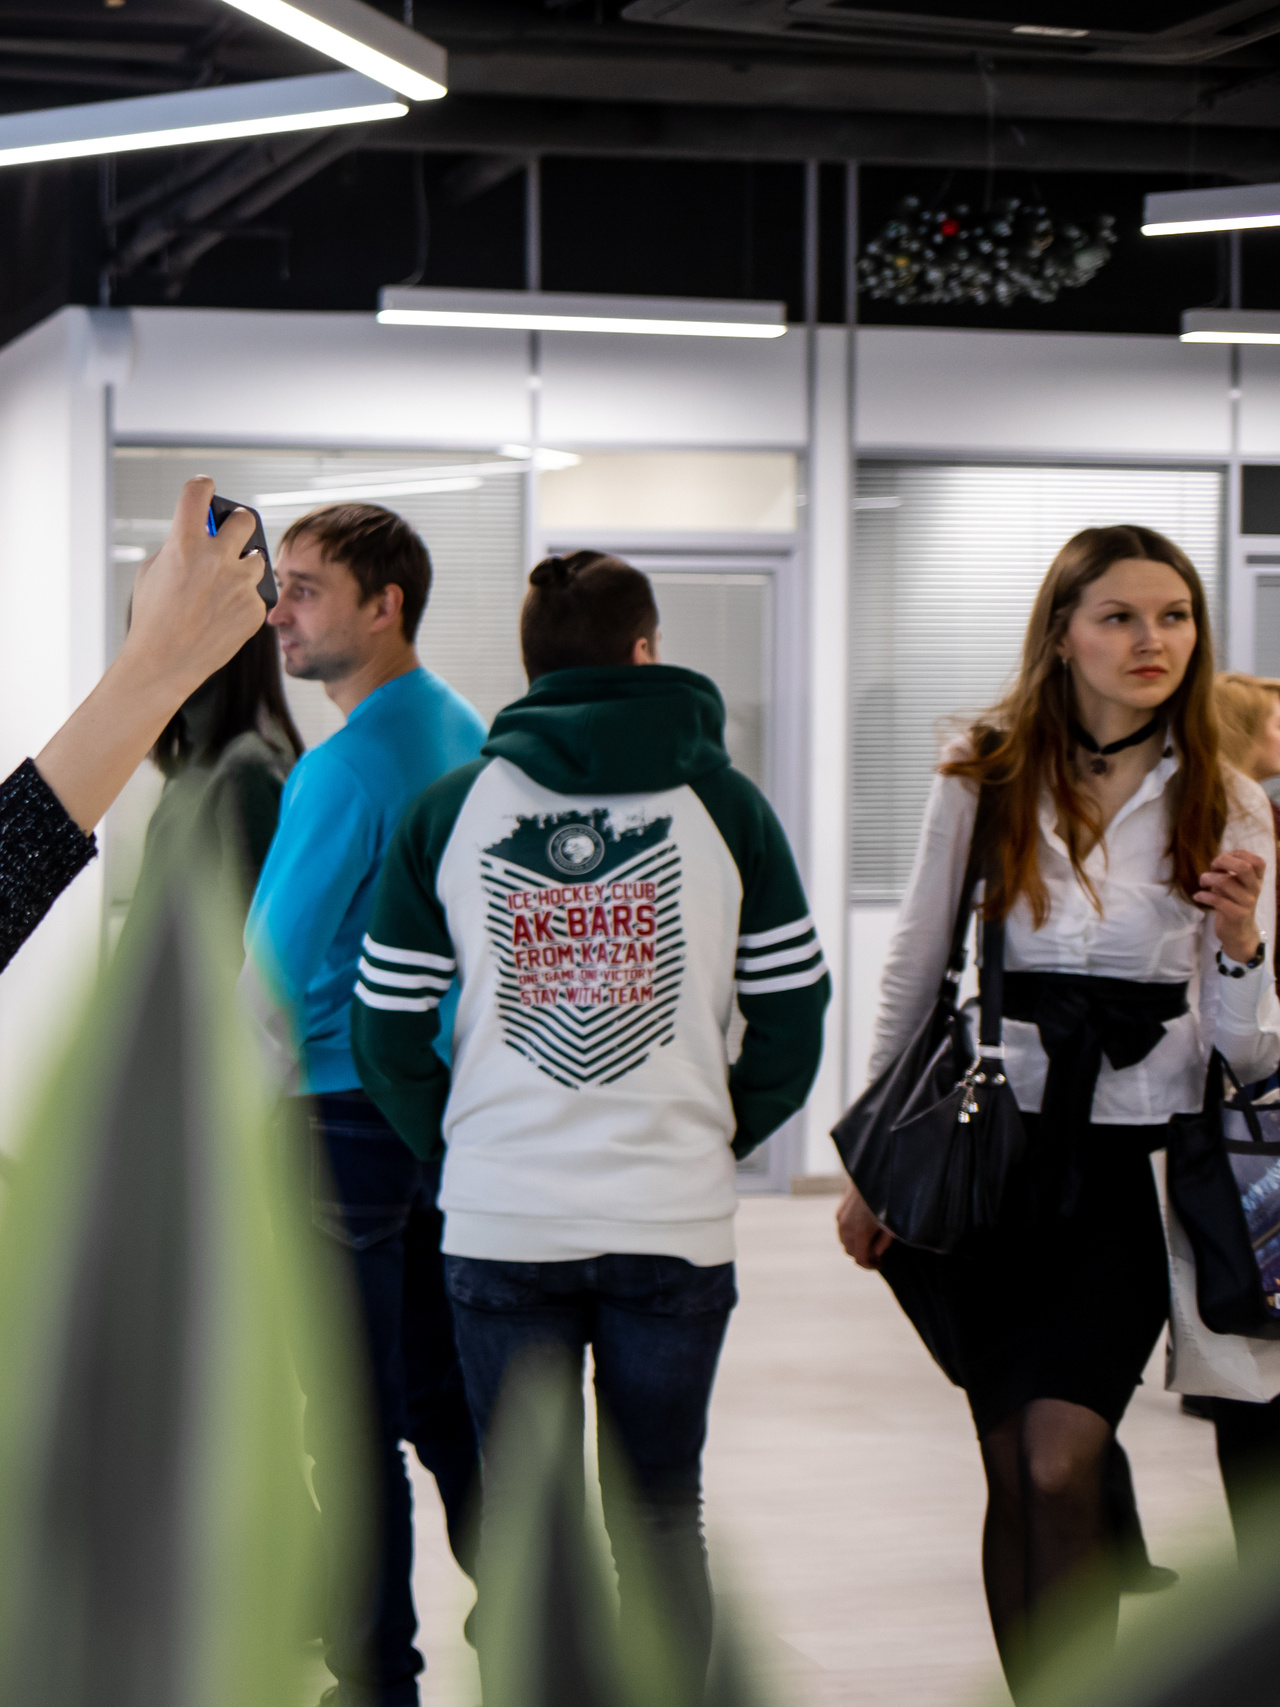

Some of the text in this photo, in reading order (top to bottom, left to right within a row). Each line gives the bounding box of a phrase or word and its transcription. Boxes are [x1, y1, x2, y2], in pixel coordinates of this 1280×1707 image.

[507, 882, 656, 910] ICE HOCKEY CLUB
[513, 904, 656, 946] AK BARS
[514, 942, 655, 970] FROM KAZAN
[518, 974, 538, 985] ONE
[544, 969, 574, 983] GAME
[603, 968, 655, 982] VICTORY
[520, 985, 654, 1006] STAY WITH TEAM
